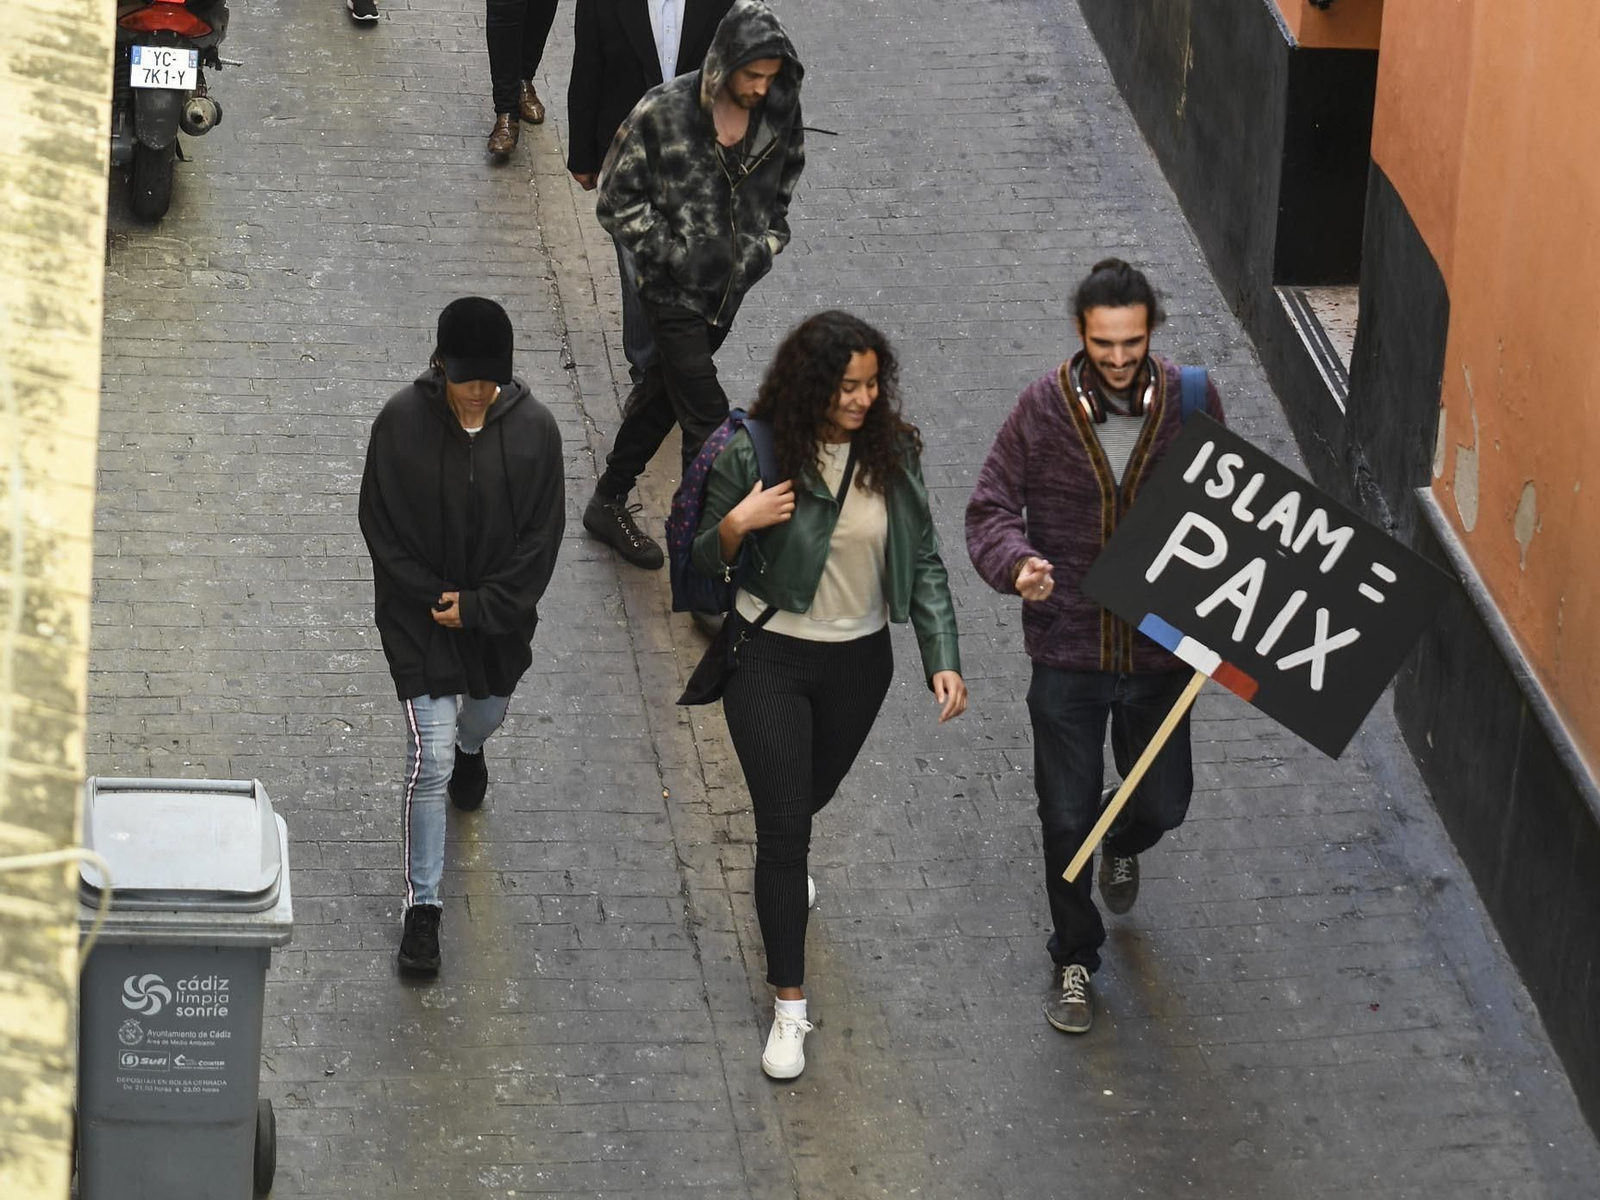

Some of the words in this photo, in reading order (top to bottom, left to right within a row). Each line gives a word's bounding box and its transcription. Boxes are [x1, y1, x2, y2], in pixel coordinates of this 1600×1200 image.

[1182, 440, 1355, 574] ISLAM
[1145, 511, 1361, 692] PAIX
[176, 974, 230, 991] cádiz
[176, 991, 229, 1006] limpia
[176, 1003, 229, 1018] sonríe
[147, 1029, 197, 1039] Ayuntamiento
[198, 1030, 208, 1039] de
[209, 1030, 232, 1039] Cádiz
[116, 1076, 156, 1085] DEPOSITAR
